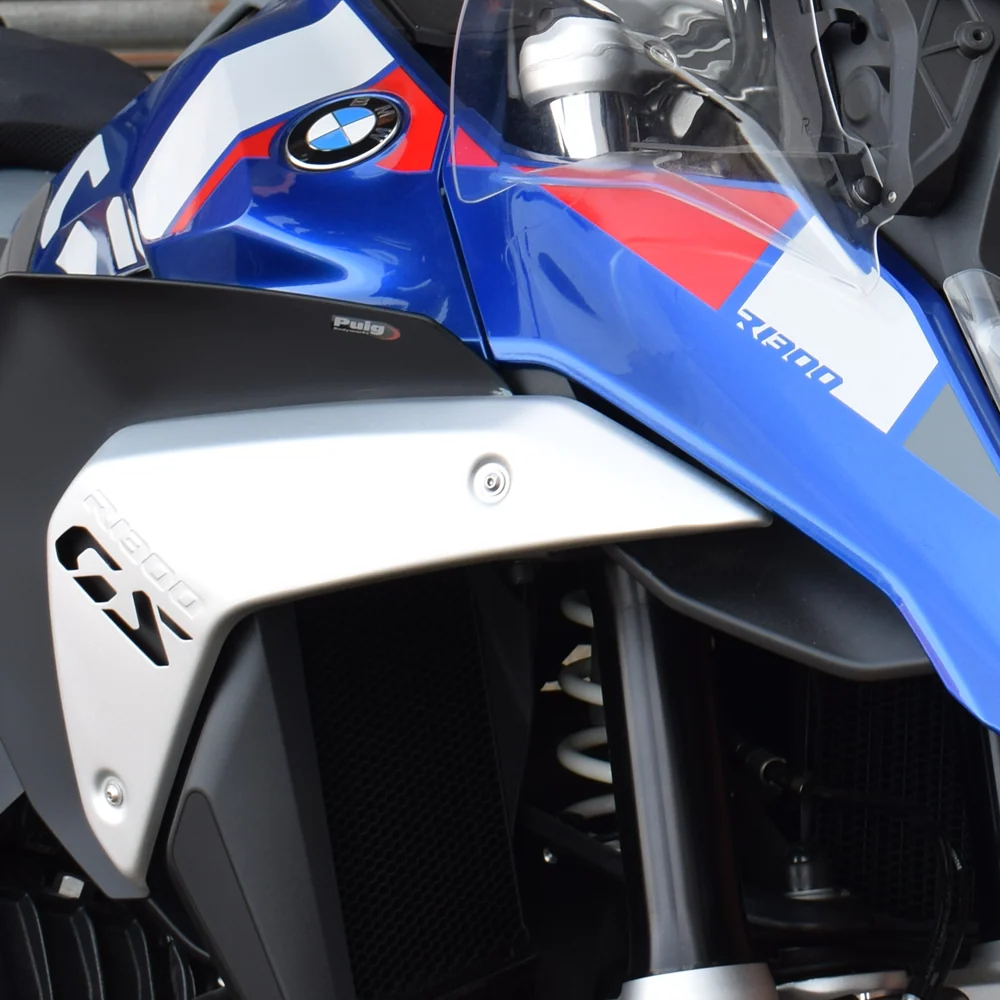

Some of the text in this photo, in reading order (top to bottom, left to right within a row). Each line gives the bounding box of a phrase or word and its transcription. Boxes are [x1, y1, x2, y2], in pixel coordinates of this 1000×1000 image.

[348, 97, 396, 143] BMW
[333, 316, 386, 336] Puig
[55, 524, 193, 667] GS
